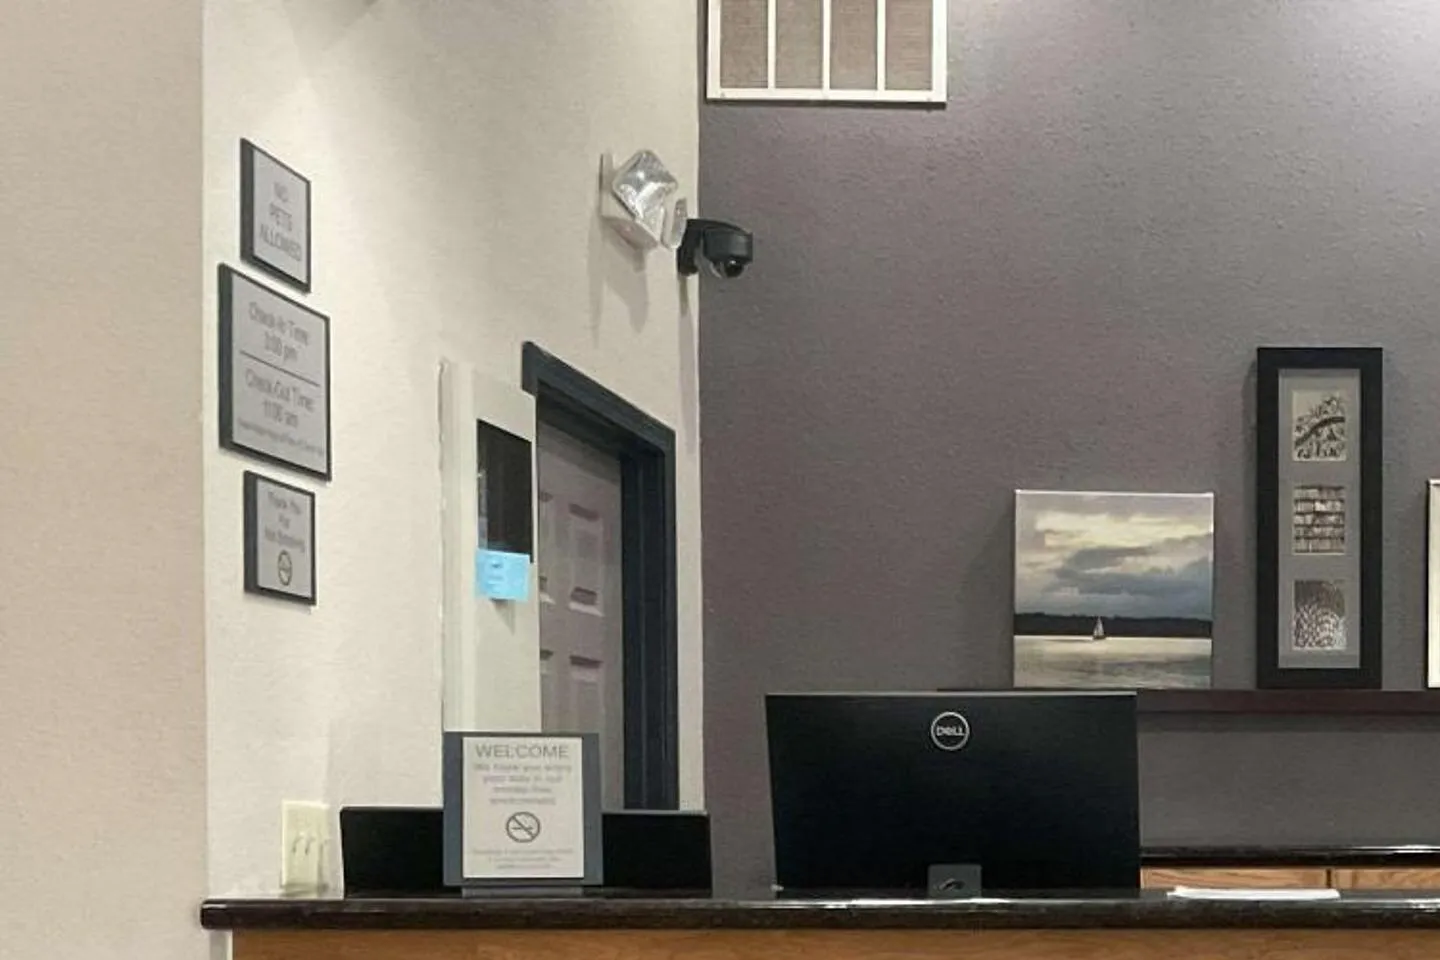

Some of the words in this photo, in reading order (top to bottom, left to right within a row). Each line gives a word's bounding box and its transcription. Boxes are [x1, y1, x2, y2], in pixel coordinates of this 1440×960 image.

[260, 222, 303, 263] ALLOWED
[936, 725, 965, 737] DELL
[475, 743, 570, 759] WELCOME
